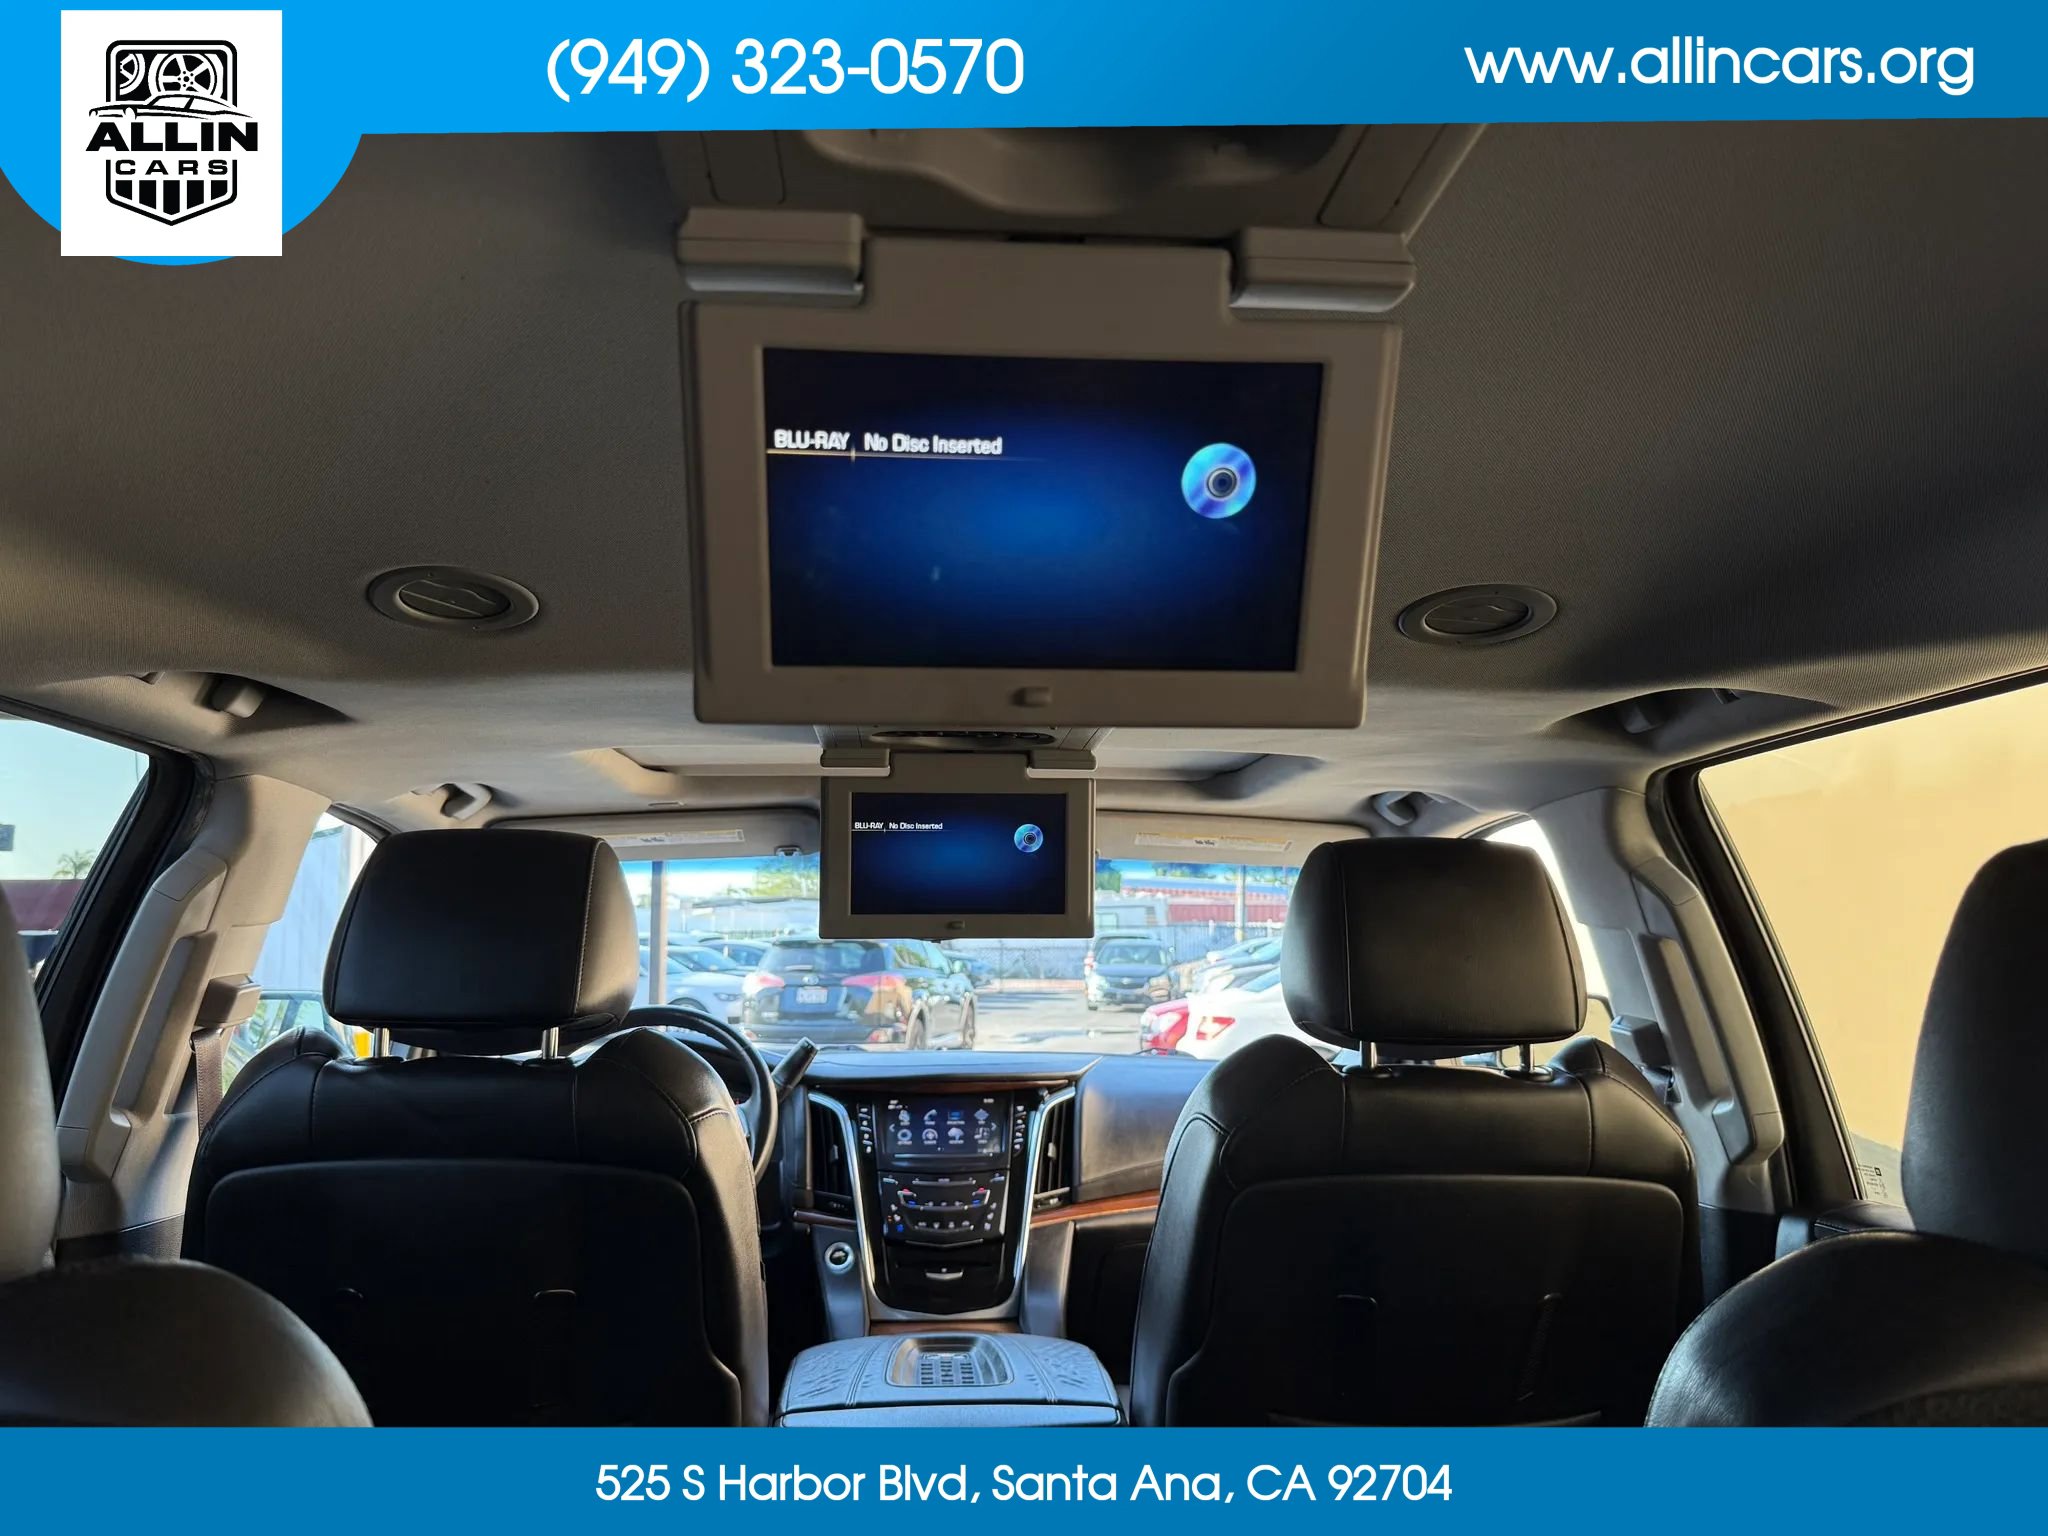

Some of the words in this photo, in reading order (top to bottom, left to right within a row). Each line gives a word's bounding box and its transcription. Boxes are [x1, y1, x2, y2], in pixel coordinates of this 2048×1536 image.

[774, 429, 850, 450] BLU-RAY
[864, 432, 888, 452] No
[892, 433, 929, 453] Disc
[933, 435, 1003, 455] Inserted
